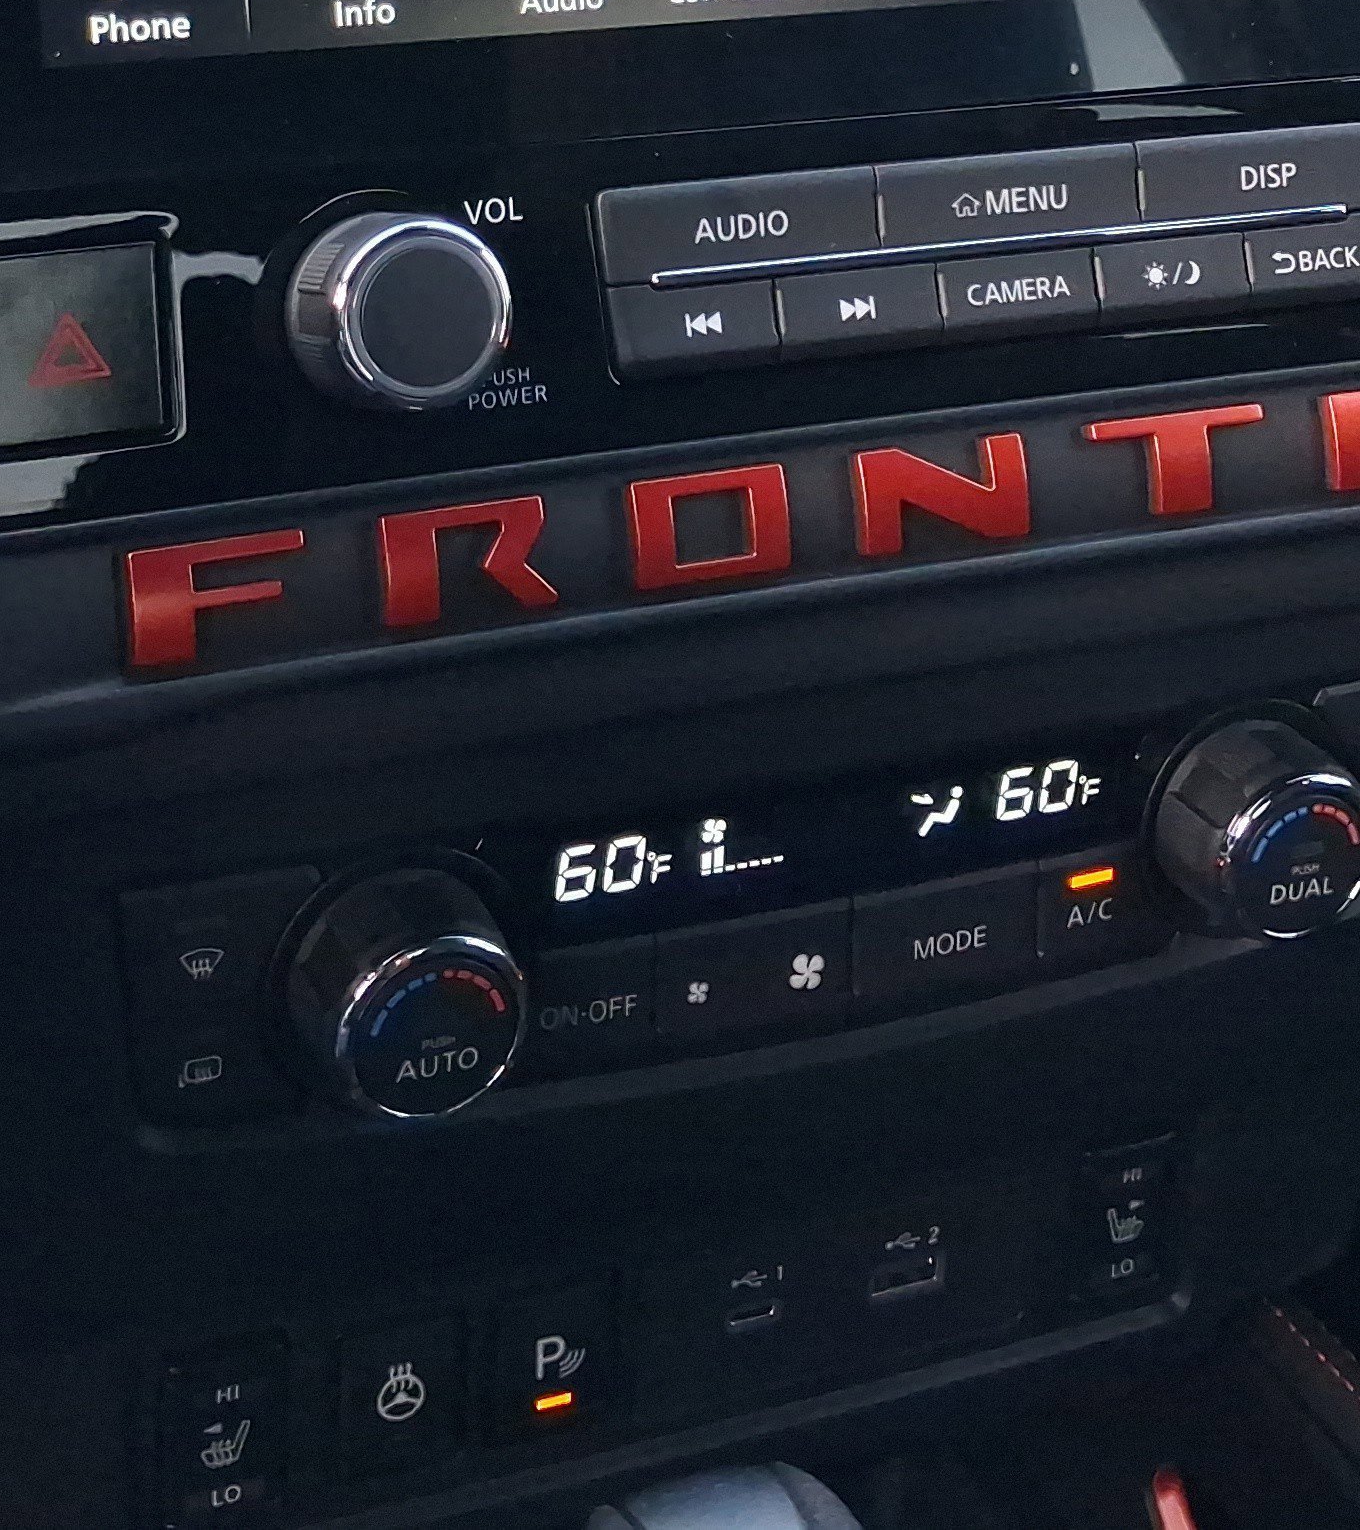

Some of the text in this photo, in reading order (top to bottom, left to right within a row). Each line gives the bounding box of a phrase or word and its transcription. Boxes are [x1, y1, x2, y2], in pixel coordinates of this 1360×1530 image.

[89, 12, 191, 45] Phone
[1240, 163, 1297, 191] DISP
[464, 197, 523, 225] VOL
[985, 185, 1069, 216] MENU
[695, 209, 789, 244] AUDIO
[1297, 245, 1360, 273] BACK
[967, 277, 1071, 307] CAMERA
[482, 366, 530, 387] USH
[468, 384, 548, 411] POWER
[1270, 876, 1335, 906] DUAL
[1066, 897, 1113, 930] A/C
[913, 925, 988, 961] MODE
[395, 1047, 479, 1084] AUTO
[217, 1384, 240, 1404] HI
[211, 1484, 241, 1507] LO
